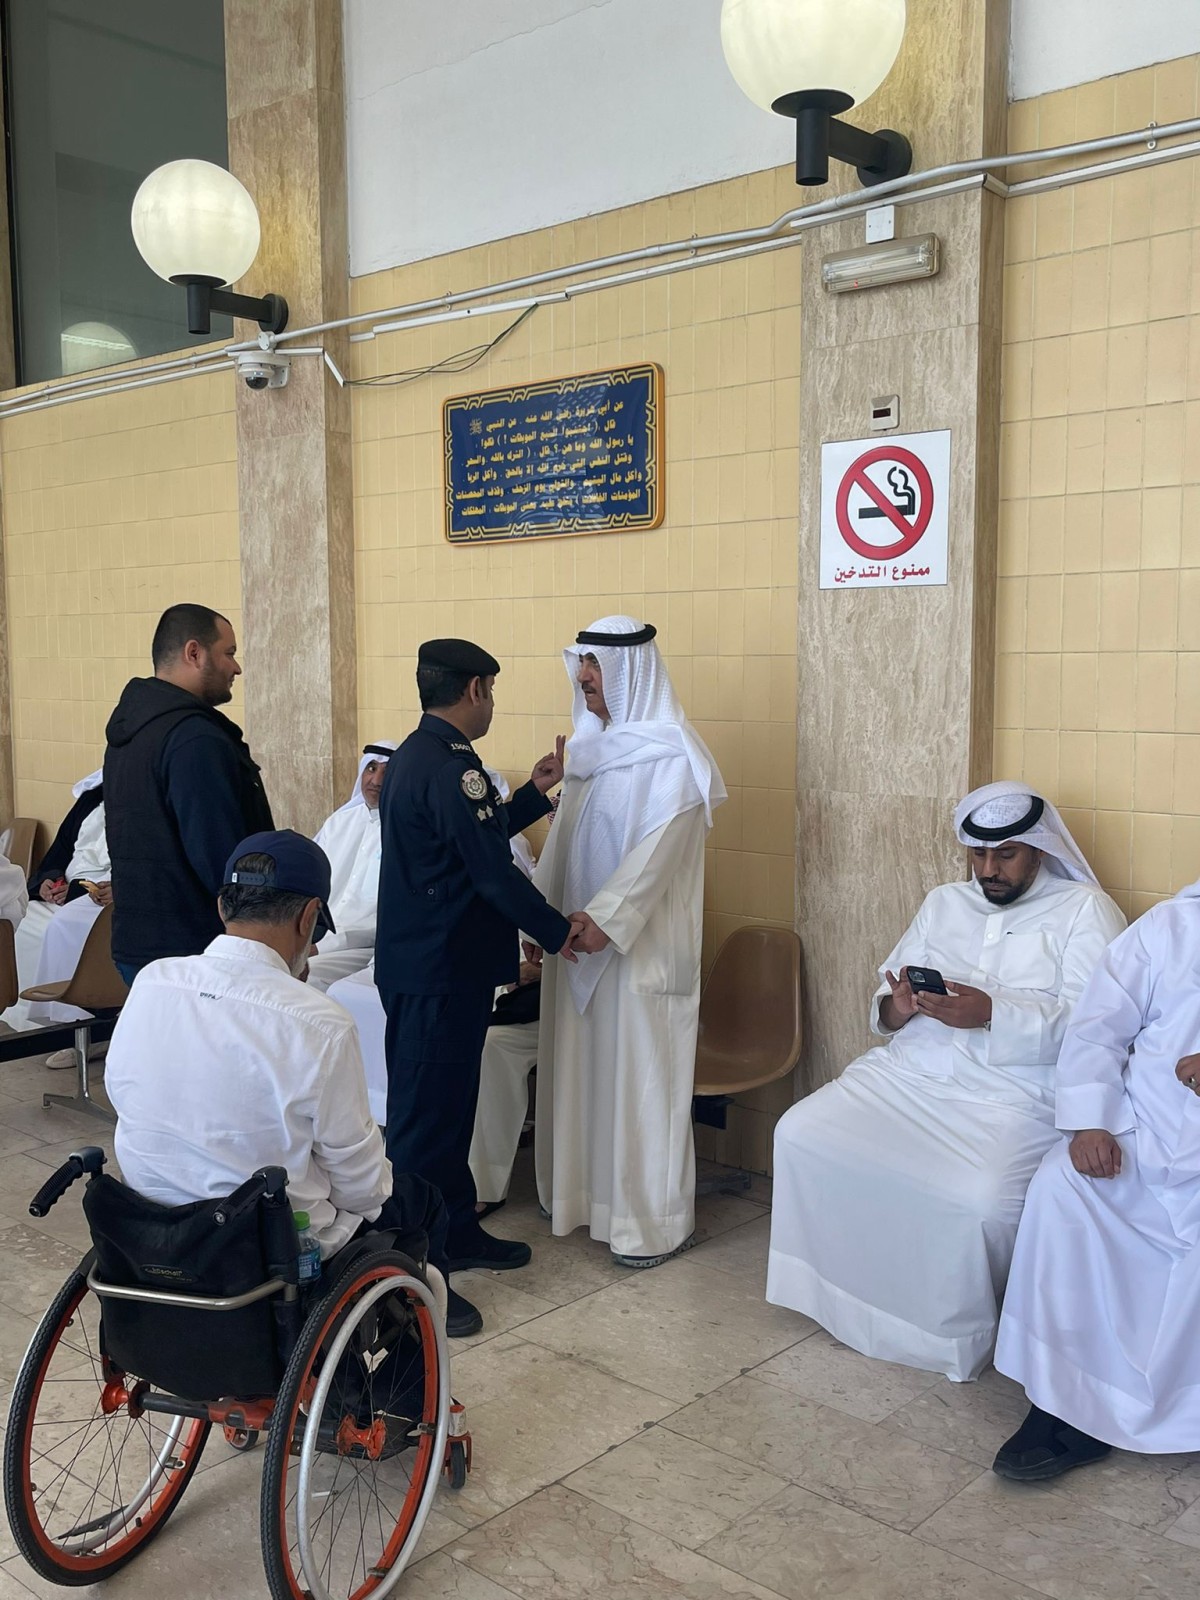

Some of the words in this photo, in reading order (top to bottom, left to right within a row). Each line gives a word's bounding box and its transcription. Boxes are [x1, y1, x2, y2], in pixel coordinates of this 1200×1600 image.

[575, 405, 595, 417] هريرة
[598, 400, 610, 416] أبي
[613, 401, 625, 412] عن
[525, 415, 537, 423] عنه
[540, 410, 553, 421] الله
[556, 409, 572, 421] رضي
[486, 418, 505, 433] النبي
[508, 418, 517, 428] عن
[604, 419, 616, 432] قال
[510, 431, 537, 444] الموبقات
[540, 427, 558, 441] السبع
[628, 434, 634, 446] يا
[574, 442, 586, 453] وما
[589, 438, 602, 449] الله
[606, 437, 625, 449] رسول
[539, 445, 550, 458] قال
[561, 445, 572, 455] هن
[490, 452, 504, 463] بالله
[589, 455, 611, 469] النفس
[614, 452, 632, 465] وقتل
[537, 462, 549, 473] الله
[570, 458, 586, 473] التي
[467, 471, 480, 484] الربا
[482, 468, 497, 482] وأكل
[505, 466, 523, 479] بالحق
[610, 472, 622, 485] مال
[625, 468, 642, 483] وأكل
[583, 474, 607, 487] اليتيم
[456, 488, 485, 500] المحصنات
[487, 486, 504, 498] وقذف
[512, 483, 531, 495] الزحف
[534, 483, 546, 496] يوم
[611, 489, 641, 502] المؤمنات
[494, 502, 518, 514] الموبقات
[834, 565, 887, 583] التدخين
[892, 563, 930, 581] ممنوع
